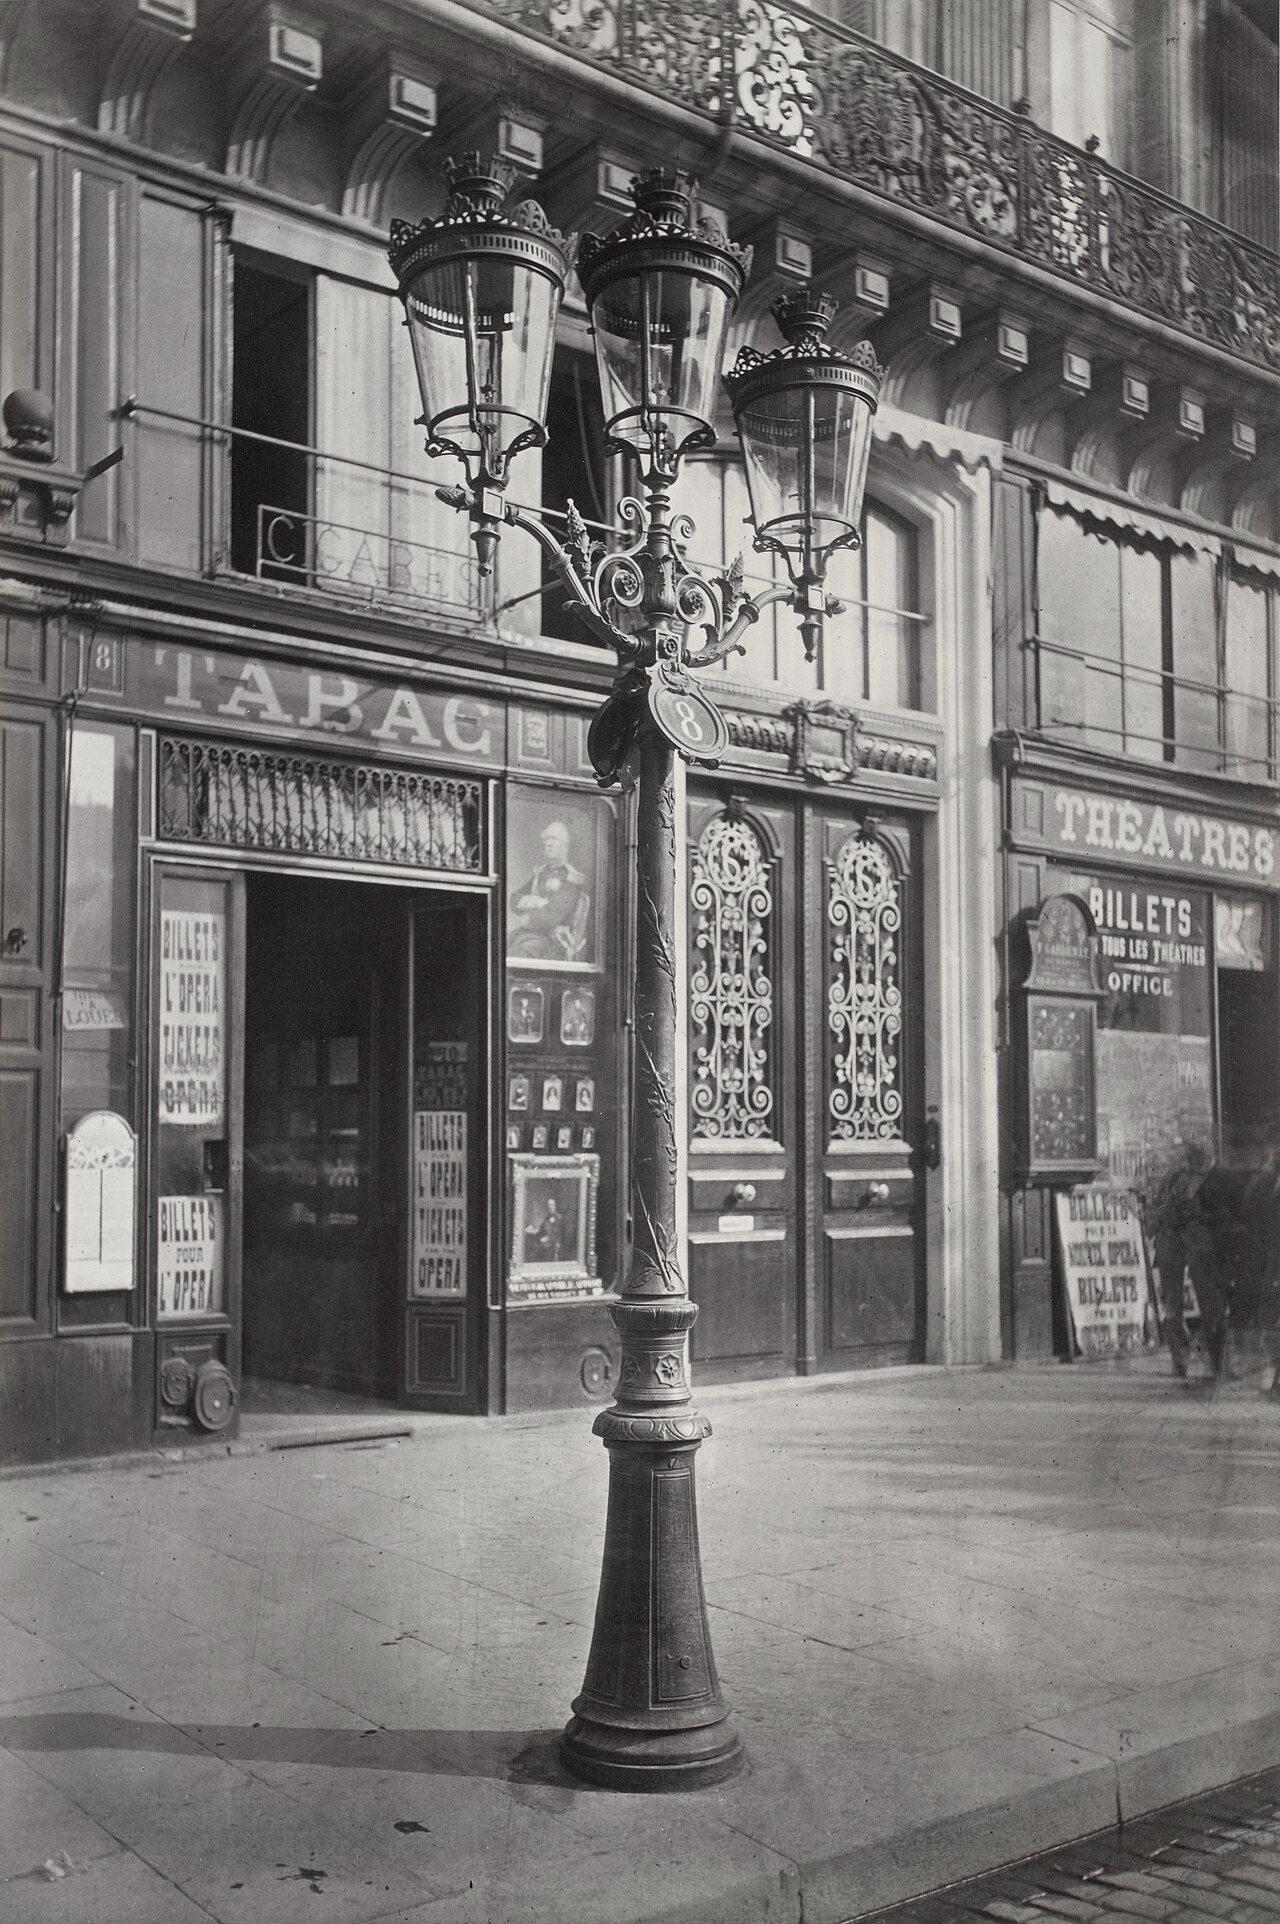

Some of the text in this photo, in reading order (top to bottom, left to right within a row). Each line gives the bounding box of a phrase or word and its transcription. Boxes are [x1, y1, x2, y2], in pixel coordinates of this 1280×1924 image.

[96, 644, 110, 672] 8
[155, 648, 492, 755] TABAC
[676, 701, 703, 741] 8
[1090, 887, 1191, 937] BILLETS
[163, 919, 219, 961] BILLETS
[1102, 935, 1126, 958] TOUS
[1129, 938, 1148, 960] LES
[1108, 972, 1173, 997] OFFICE
[163, 1024, 219, 1068] TICKETS
[418, 1114, 464, 1151] BILLETS
[160, 1200, 216, 1243] BILLETS
[418, 1208, 465, 1246] TICKETS
[176, 1247, 204, 1264] POUR
[418, 1258, 461, 1289] OPERA
[1078, 1275, 1138, 1305] BILLETS
